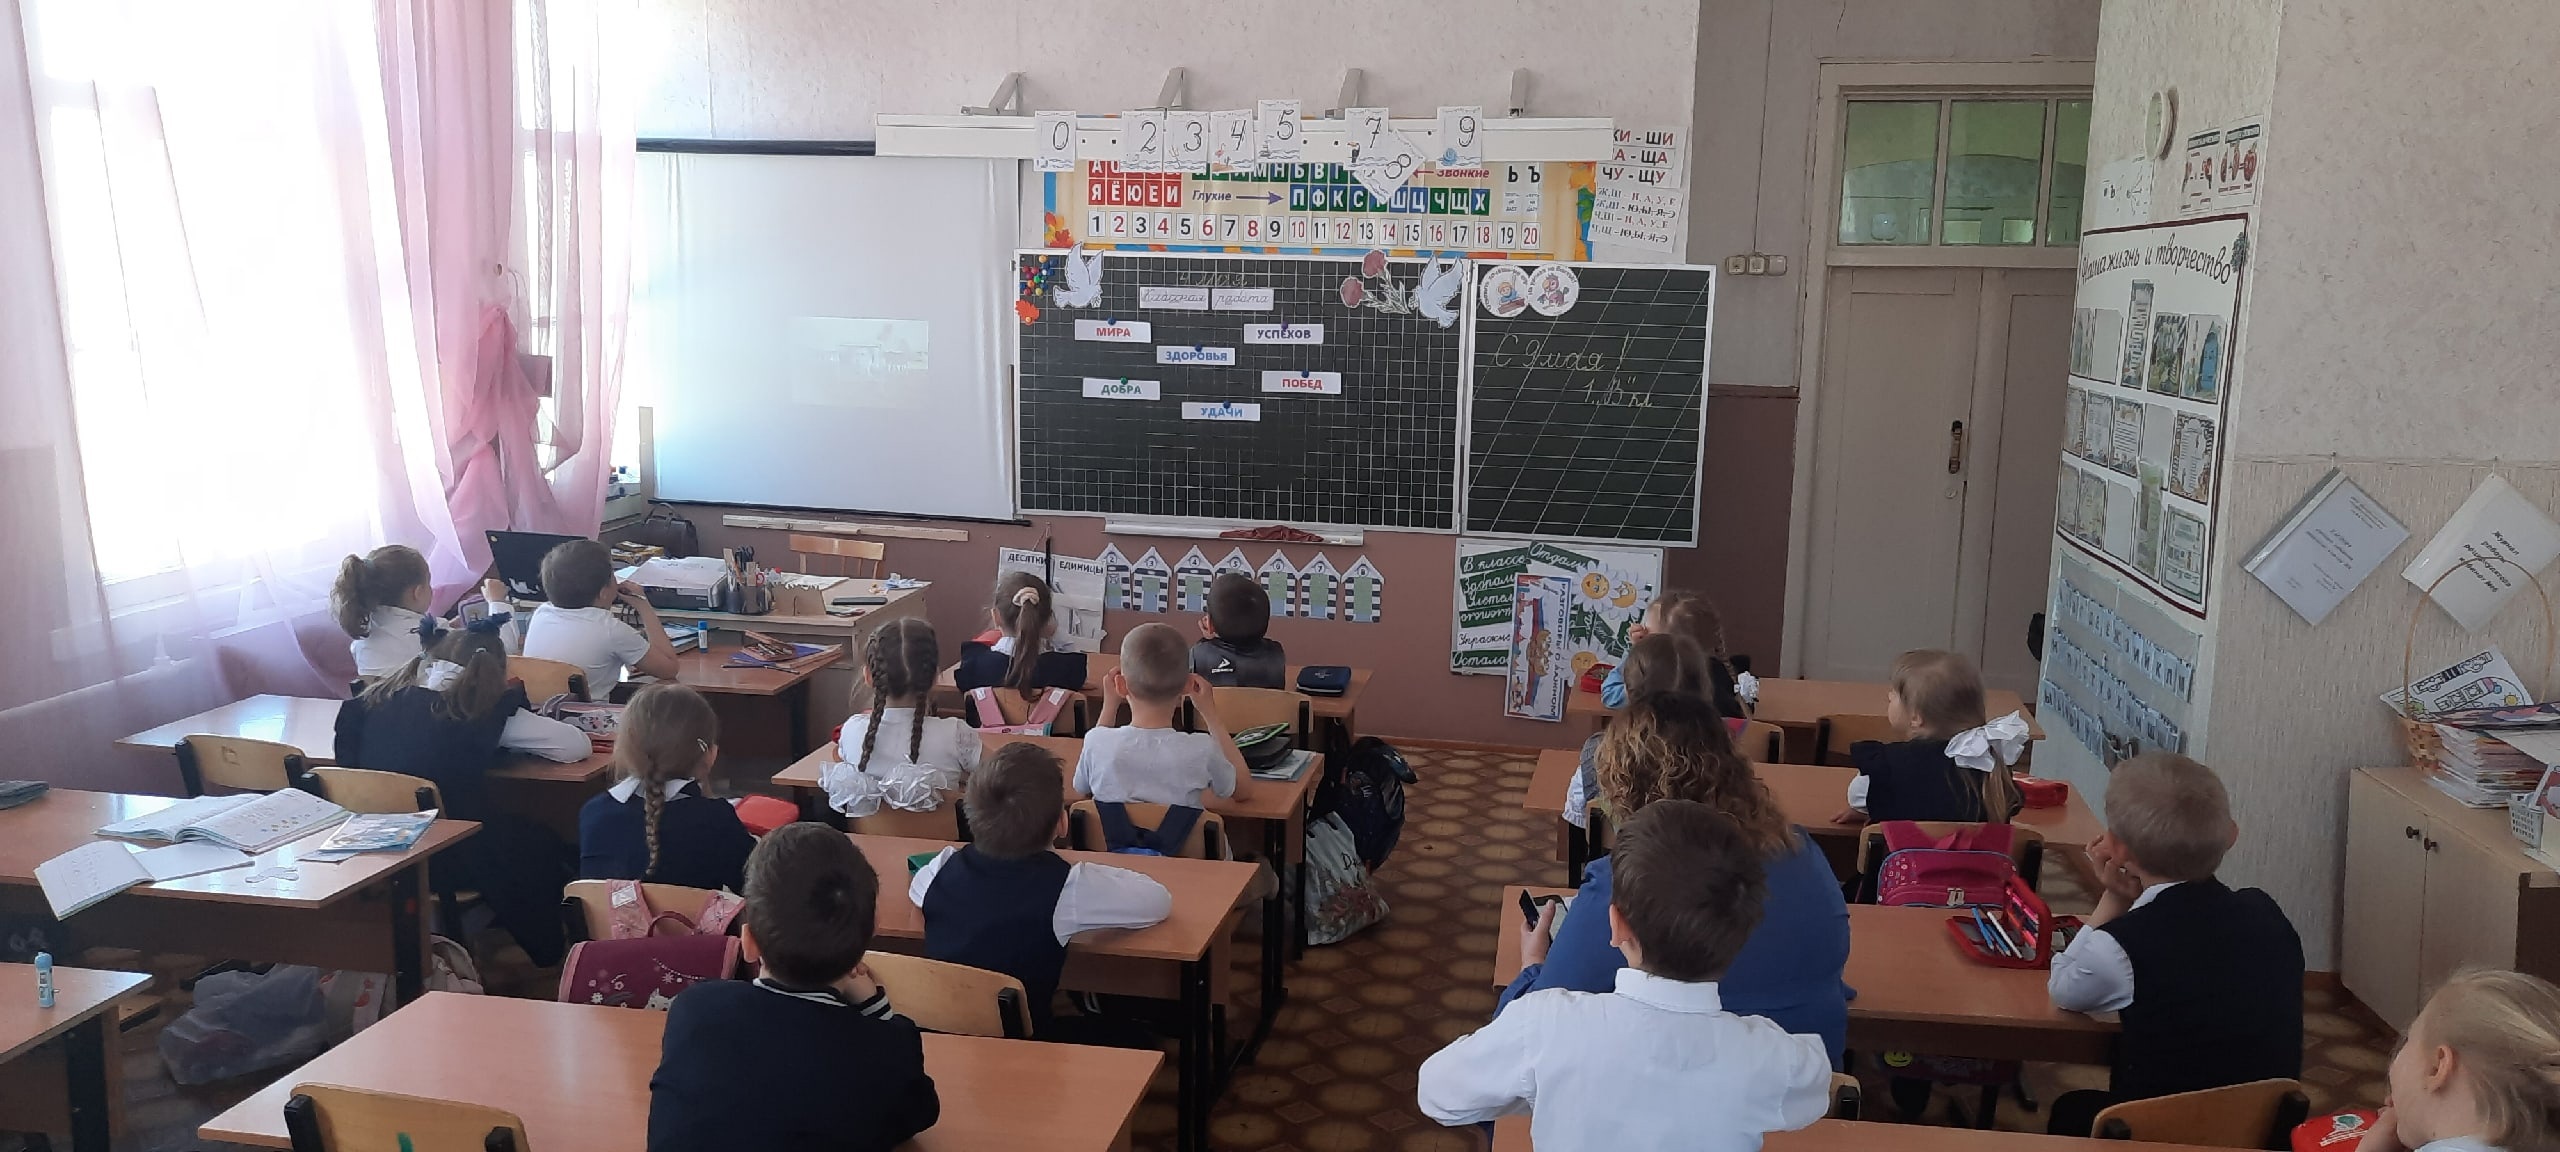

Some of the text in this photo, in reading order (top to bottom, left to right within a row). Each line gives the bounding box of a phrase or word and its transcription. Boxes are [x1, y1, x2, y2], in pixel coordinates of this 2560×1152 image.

[1277, 109, 1295, 140] 5
[1365, 117, 1382, 149] 7
[1459, 116, 1476, 148] 9
[1052, 120, 1069, 150] 0
[1140, 121, 1157, 153] 2
[1183, 120, 1203, 151] 3
[1231, 119, 1248, 151] 4
[1613, 129, 1631, 143] И
[1646, 132, 1674, 145] ШИ
[1384, 154, 1412, 180] 8
[1641, 150, 1668, 166] ЩА
[1508, 165, 1541, 183] Ь Ъ
[1602, 167, 1624, 180] ЧУ
[1639, 170, 1666, 186] ЩУ
[1192, 190, 1232, 203] Глухие
[1092, 216, 1538, 245] 1 2 3 4 5 6 7 8 9 10 11 12 13 14 15 16 17 18 19 20
[2107, 248, 2140, 272] жизнь
[2144, 245, 2152, 266] и
[2155, 232, 2231, 284] творчество
[1095, 327, 1132, 339] МИРА
[1256, 328, 1312, 341] УСПЕХОВ
[1165, 351, 1228, 363] ЗДОРОВЬЯ
[1101, 384, 1142, 396] ДОБРА
[1282, 378, 1323, 391] ПОБЕД
[1200, 406, 1243, 419] УДАЧИ
[2492, 531, 2520, 555] Журнал
[1059, 561, 1104, 575] ЕДИНИЦЫ
[1463, 556, 1474, 572] В
[1453, 651, 1509, 667] Остало
